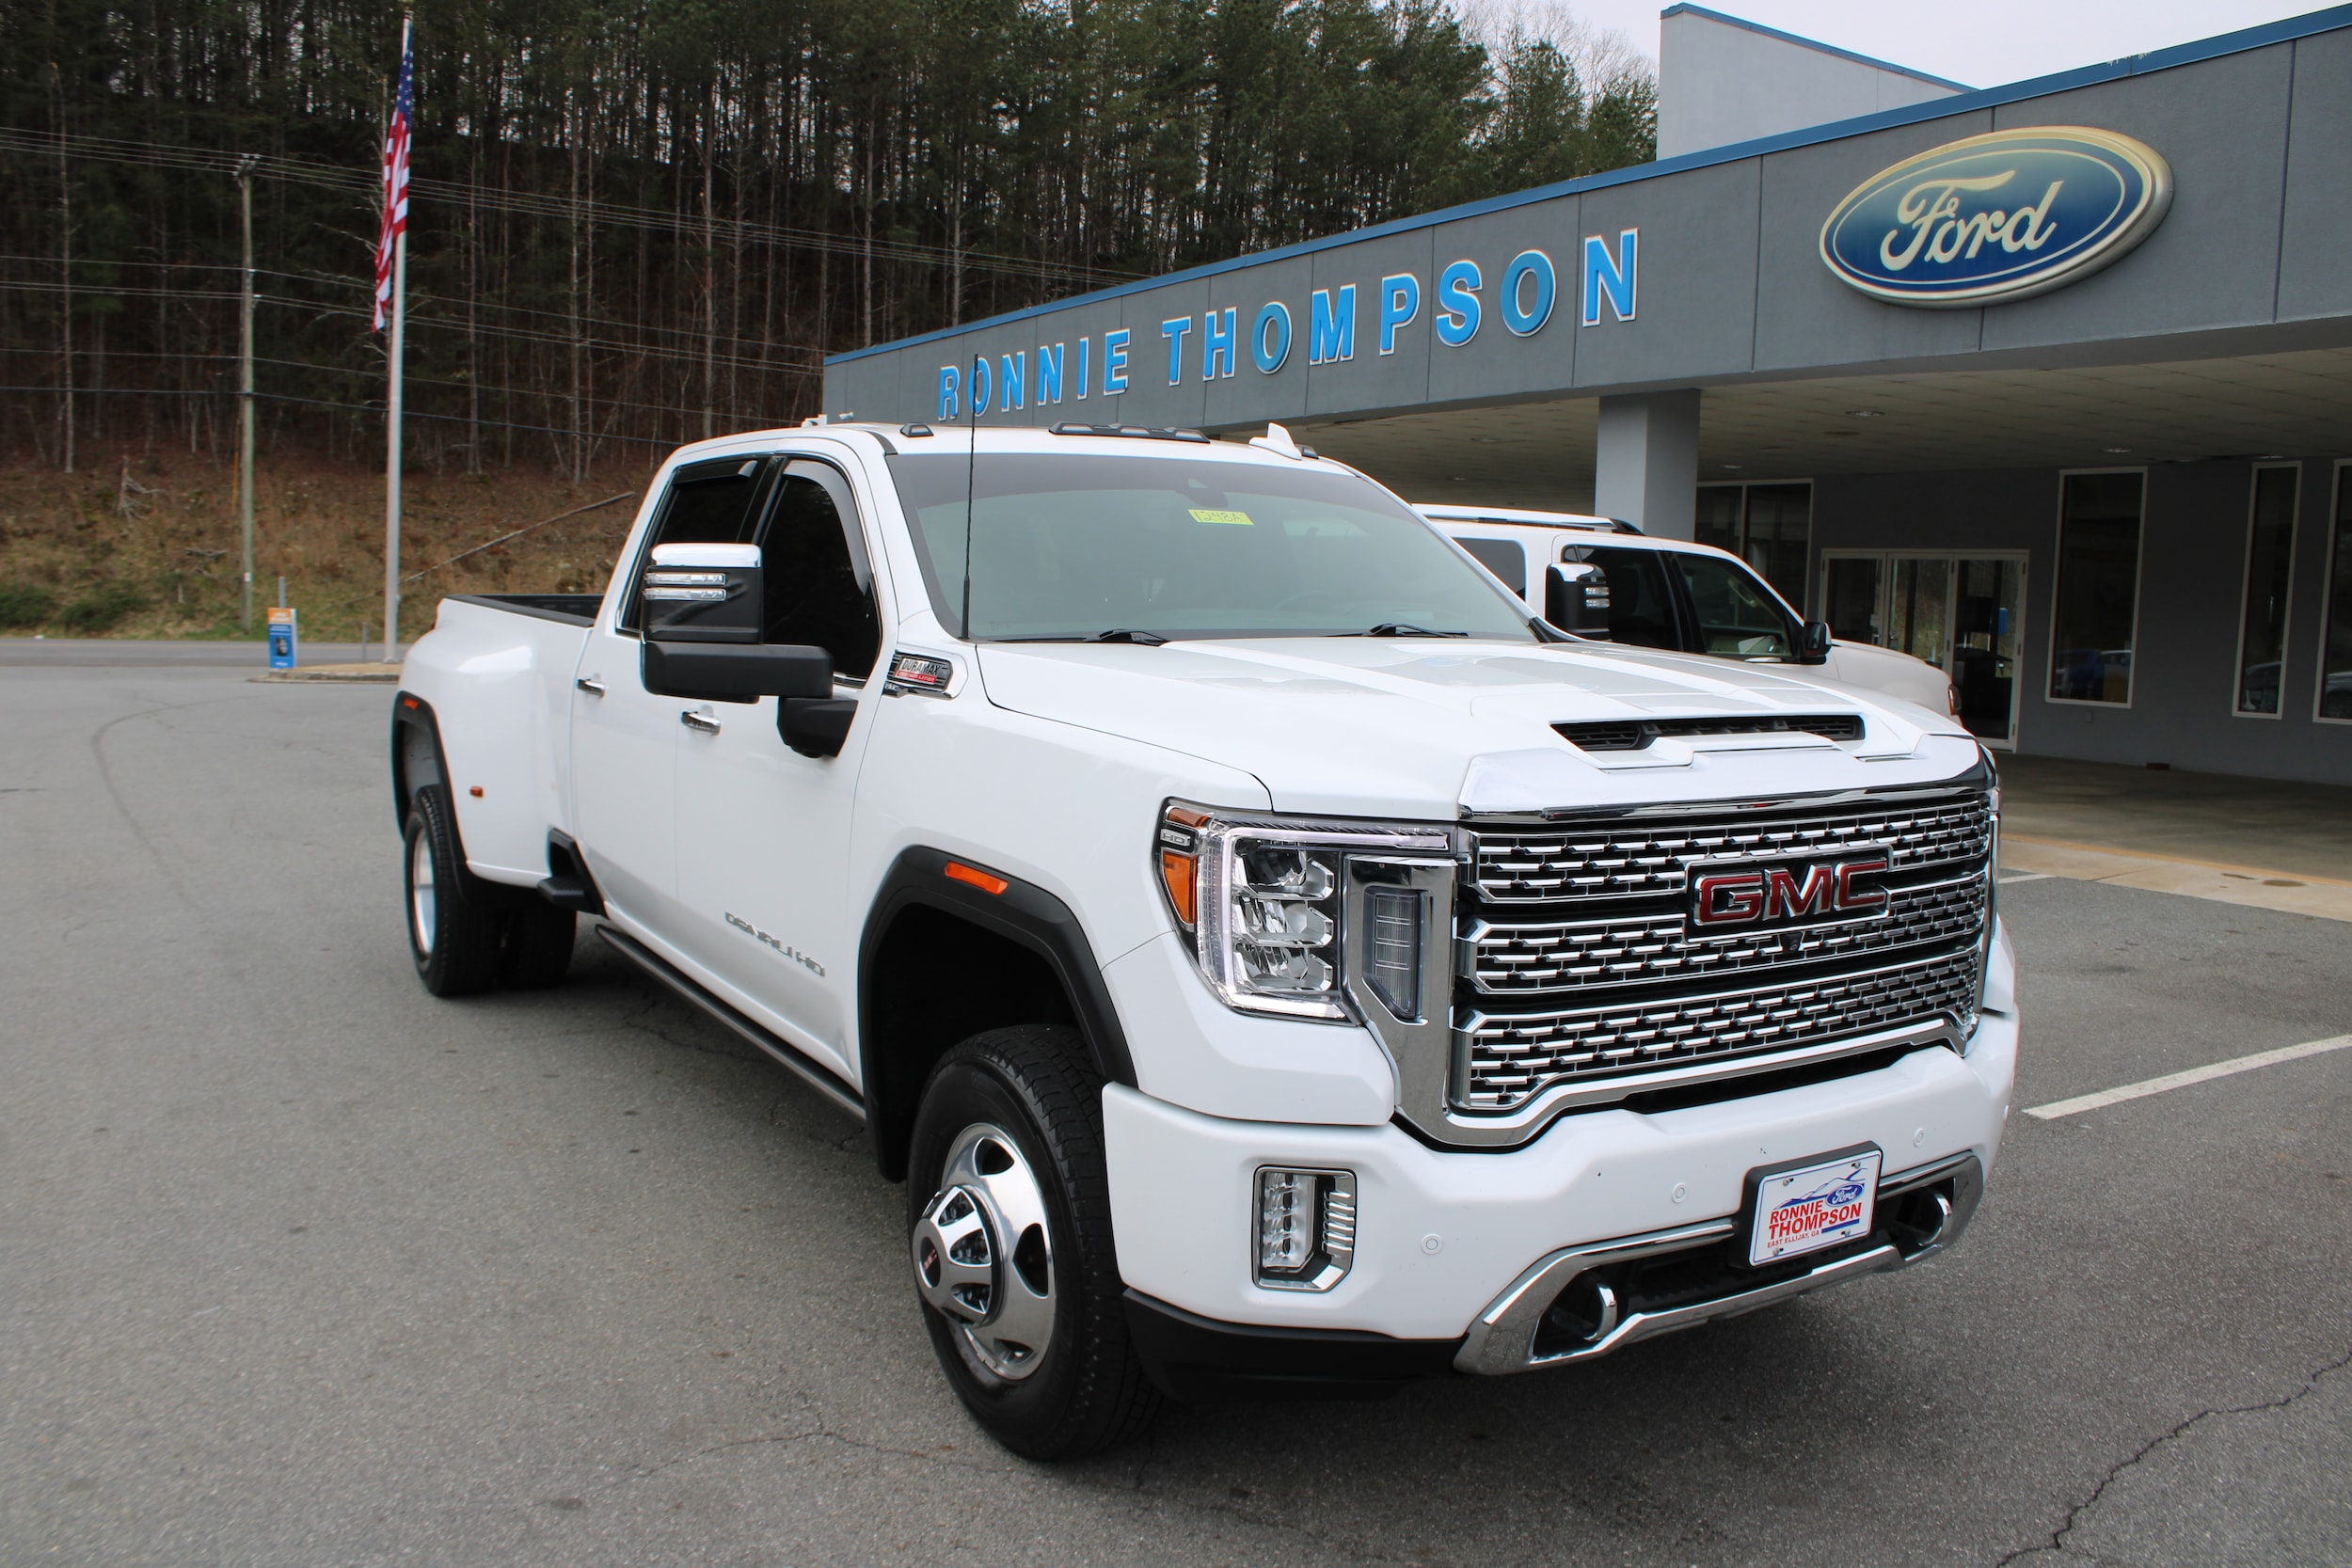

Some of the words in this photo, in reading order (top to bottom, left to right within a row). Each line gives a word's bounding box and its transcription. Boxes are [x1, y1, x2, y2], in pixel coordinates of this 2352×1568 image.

[1880, 169, 2064, 272] Ford
[937, 328, 1129, 422] RONNIE
[1162, 228, 1640, 387] THOMPSON
[901, 659, 940, 675] DURAMAX
[1162, 831, 1188, 846] HD
[1694, 856, 1887, 926] GMC
[1832, 1184, 1859, 1205] Ford
[1769, 1202, 1862, 1240] THOMPSON
[1770, 1200, 1823, 1224] RONNIE
[1767, 1239, 1783, 1248] EAST
[1785, 1232, 1810, 1243] ELLIJAY,
[1811, 1230, 1820, 1239] GA
